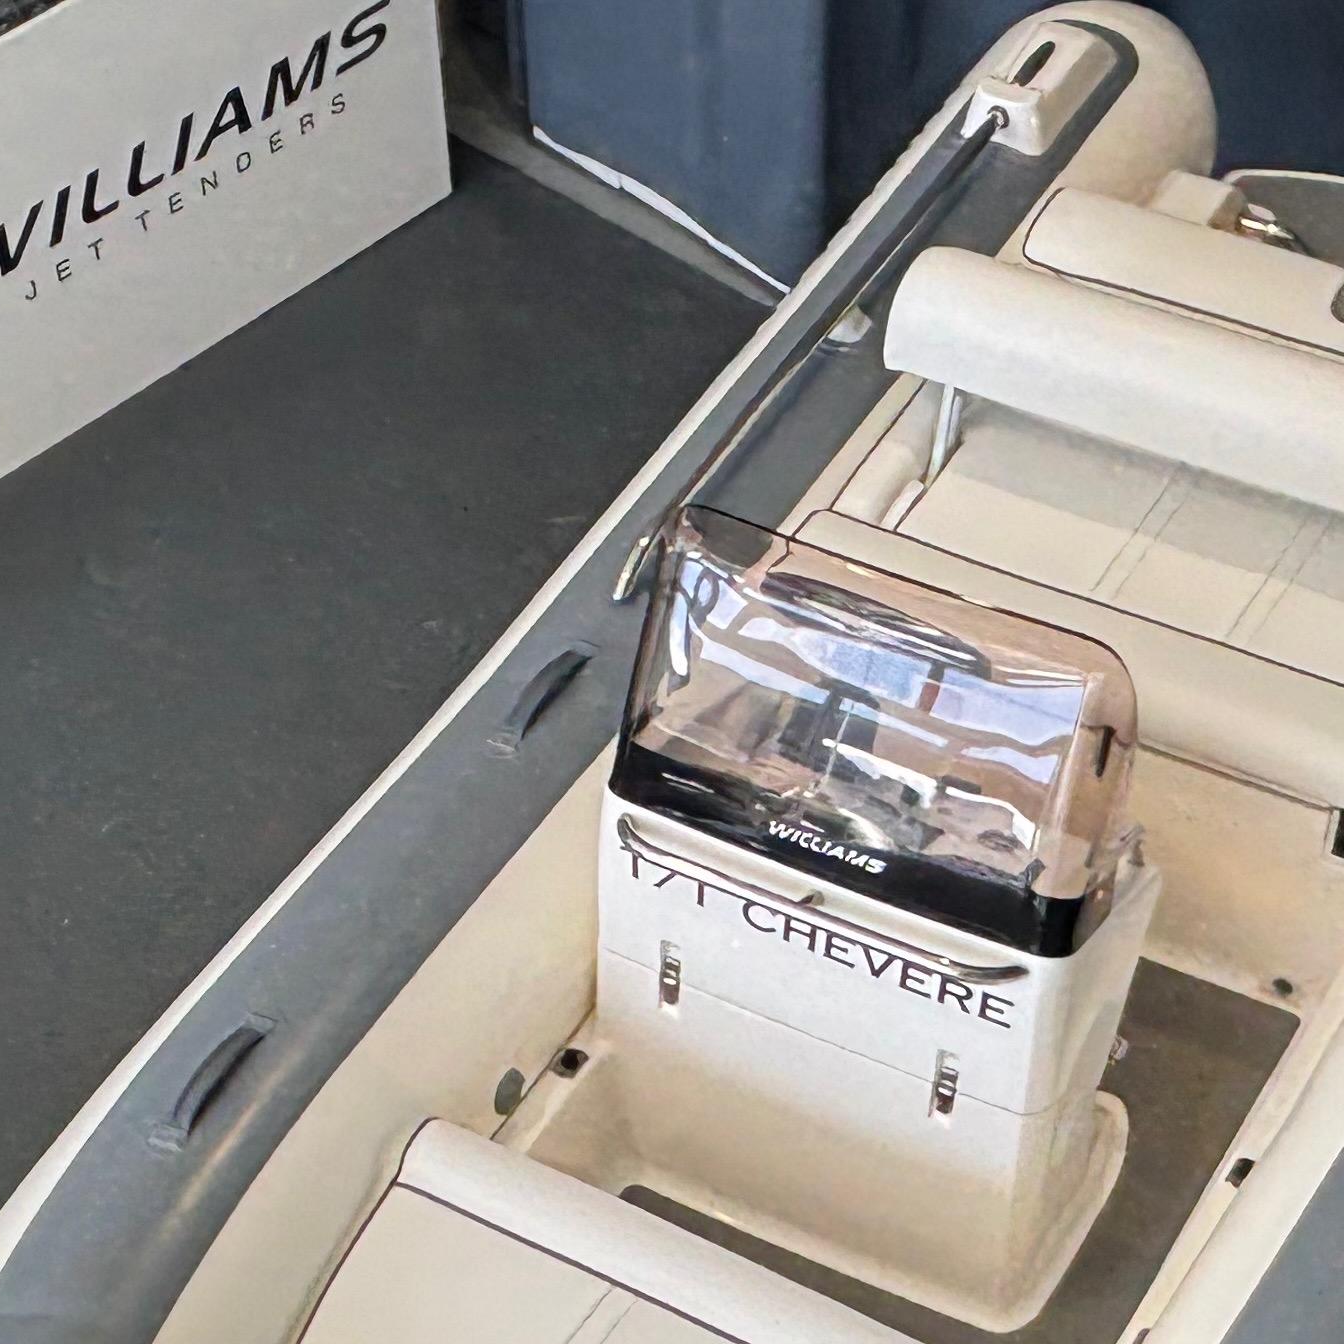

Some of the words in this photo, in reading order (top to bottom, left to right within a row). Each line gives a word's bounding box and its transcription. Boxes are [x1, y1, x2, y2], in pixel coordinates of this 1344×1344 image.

[24, 238, 105, 301] JET
[135, 92, 346, 232] TENDERS
[768, 819, 888, 875] WILLIAMS
[741, 897, 1015, 1029] CHEVERE
